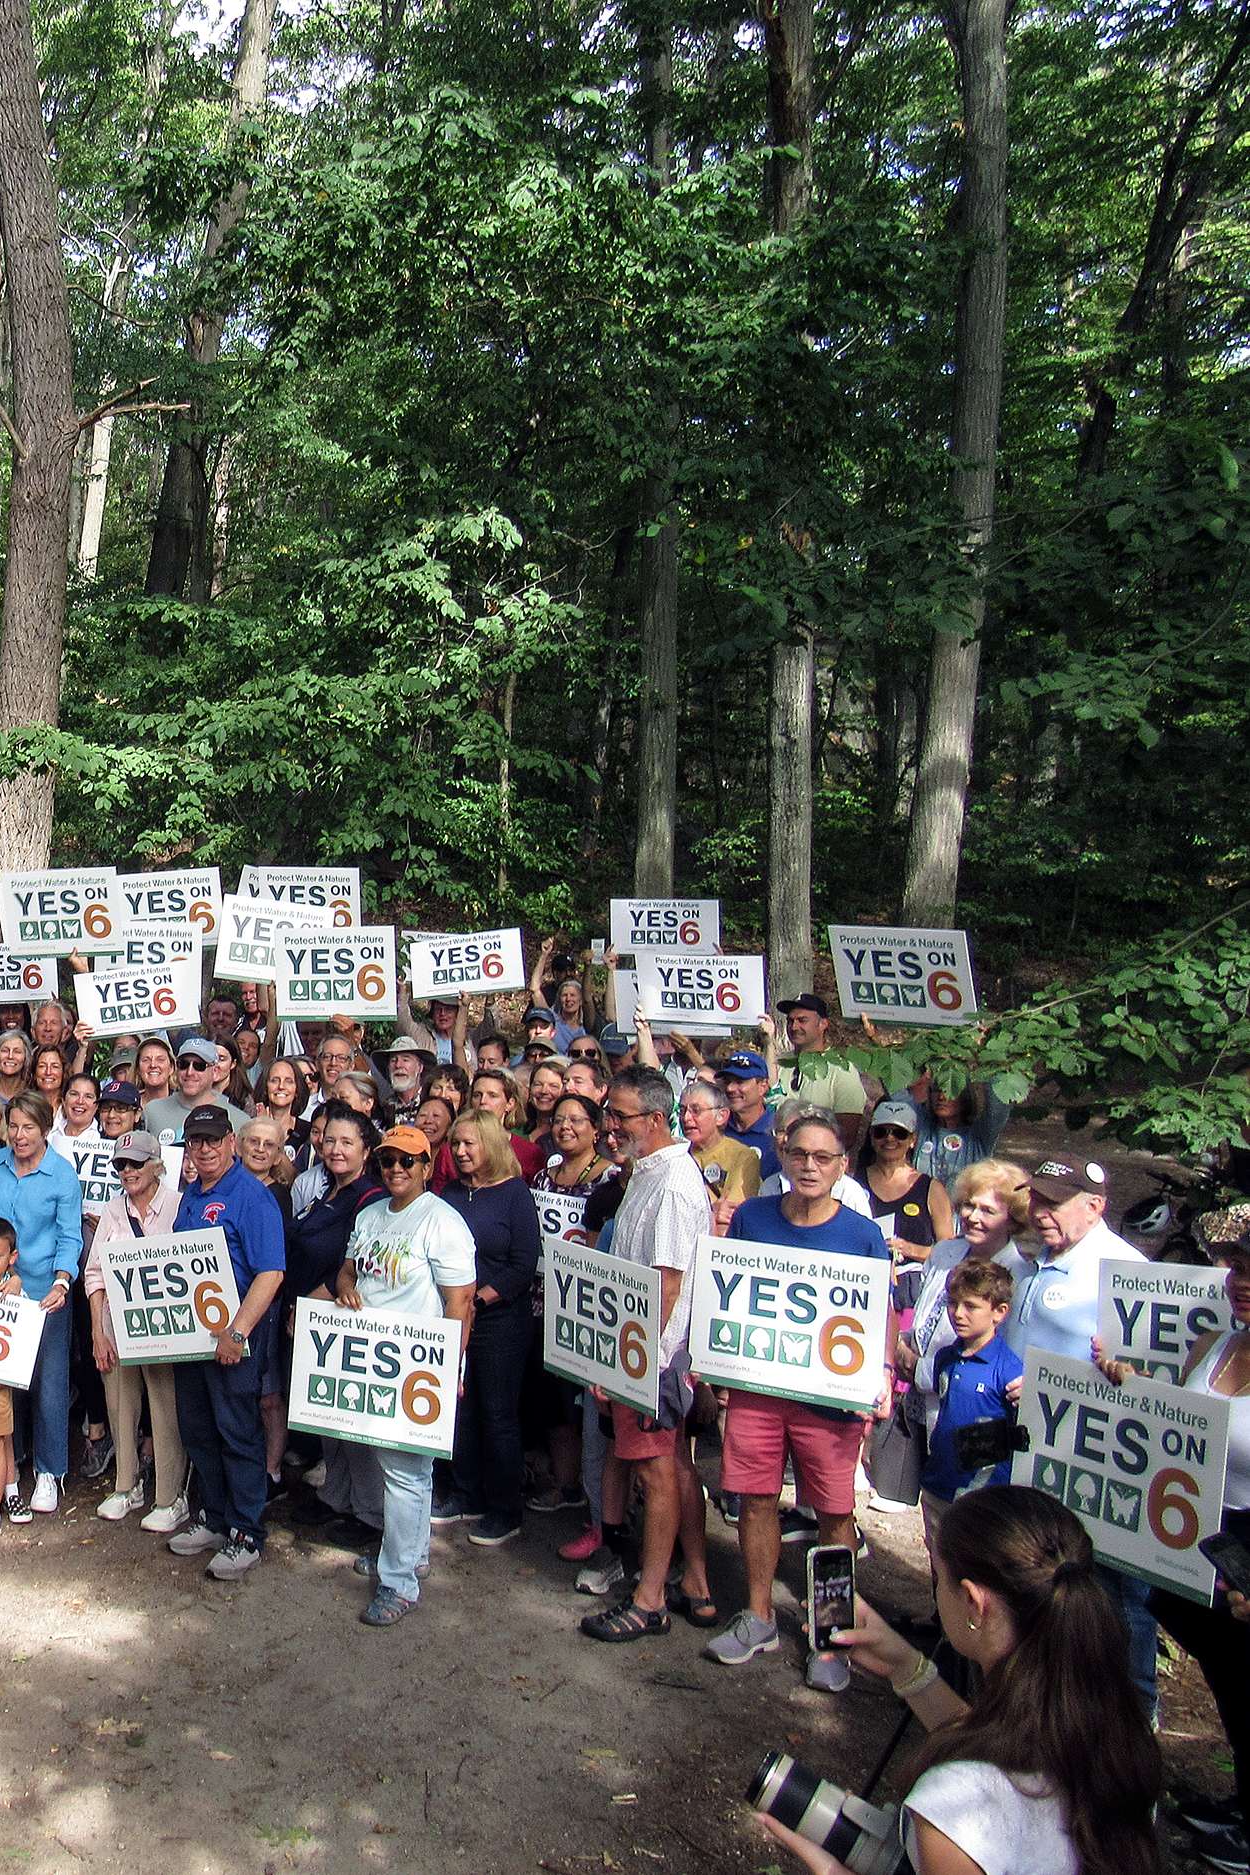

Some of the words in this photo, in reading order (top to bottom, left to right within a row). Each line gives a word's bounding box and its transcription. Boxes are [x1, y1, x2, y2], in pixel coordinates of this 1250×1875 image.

[13, 890, 81, 917] YES
[84, 887, 108, 900] ON
[125, 889, 186, 915] YES
[190, 886, 212, 899] ON
[269, 885, 326, 907] YES
[330, 885, 351, 897] ON
[83, 904, 112, 939] 6
[189, 902, 215, 933] 6
[232, 903, 263, 915] Protect
[289, 911, 295, 919] &
[296, 911, 324, 922] Nature
[330, 900, 353, 927] 6
[629, 910, 679, 928] YES
[682, 909, 700, 918] ON
[284, 936, 317, 945] Protect
[318, 935, 345, 944] Water
[345, 936, 353, 945] &
[354, 935, 384, 944] Nature
[679, 921, 700, 945] 6
[839, 935, 877, 946] Protect
[877, 937, 908, 947] Water
[909, 939, 917, 948] &
[918, 939, 953, 950] Nature
[169, 940, 192, 953] ON
[360, 947, 384, 960] ON
[430, 945, 480, 967] YES
[483, 941, 502, 952] ON
[927, 952, 956, 967] ON
[285, 948, 355, 975] YES
[481, 954, 504, 979] 6
[655, 957, 682, 965] Protect
[683, 957, 705, 965] Water
[706, 958, 712, 966] &
[713, 958, 739, 966] Nature
[718, 968, 739, 979] ON
[842, 948, 923, 980] YES
[23, 964, 43, 990] 6
[153, 974, 172, 986] ON
[357, 964, 386, 1002] 6
[657, 967, 714, 990] YES
[95, 979, 150, 1004] YES
[153, 988, 177, 1017] 6
[716, 982, 741, 1012] 6
[927, 971, 962, 1010] 6
[191, 1256, 219, 1276] ON
[710, 1249, 760, 1269] Protect
[763, 1256, 805, 1274] Water
[807, 1263, 818, 1277] &
[820, 1264, 870, 1284] Nature
[112, 1262, 189, 1303] YES
[1112, 1274, 1159, 1293] Protect
[1163, 1279, 1205, 1299] Water
[1207, 1283, 1217, 1299] &
[194, 1281, 230, 1333] 6
[553, 1269, 618, 1327] YES
[624, 1292, 648, 1318] ON
[711, 1270, 817, 1325] YES
[828, 1285, 868, 1310] ON
[309, 1311, 352, 1329] Protect
[355, 1317, 390, 1334] Water
[392, 1324, 401, 1336] &
[403, 1325, 445, 1342] Nature
[309, 1329, 401, 1379] YES
[410, 1344, 444, 1365] ON
[619, 1320, 649, 1378] 6
[817, 1315, 864, 1375] 6
[401, 1370, 441, 1424] 6
[1037, 1366, 1089, 1395] Protect
[1092, 1380, 1136, 1407] Water
[1138, 1394, 1150, 1411] &
[1153, 1397, 1208, 1428] Nature
[1037, 1391, 1148, 1473] YES
[1161, 1426, 1206, 1462] ON
[1148, 1465, 1201, 1549] 6
